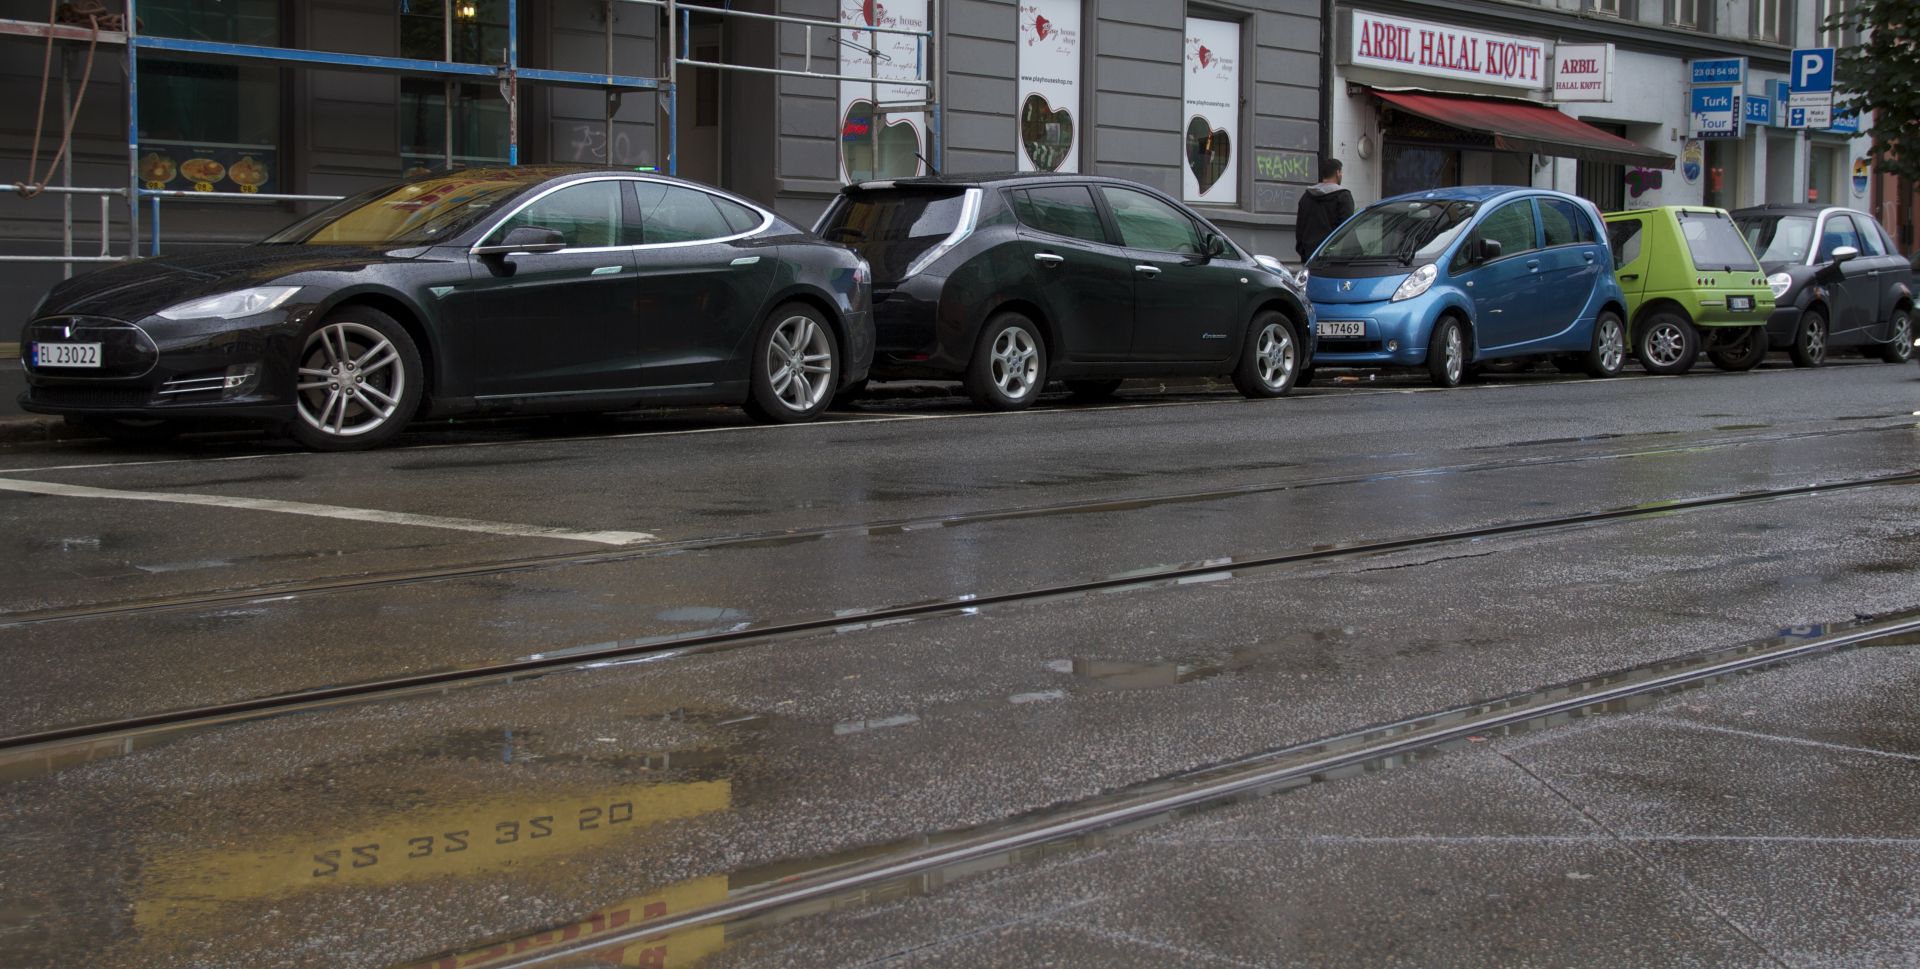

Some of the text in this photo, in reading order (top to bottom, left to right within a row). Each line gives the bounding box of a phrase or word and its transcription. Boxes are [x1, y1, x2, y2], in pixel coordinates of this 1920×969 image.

[899, 15, 923, 27] house
[1358, 19, 1541, 81] ARBIL HALAL KJØTT
[1561, 59, 1599, 74] ARBIL
[1705, 68, 1715, 76] 03
[1800, 54, 1824, 88] P
[1021, 75, 1073, 86] www.playhouseshop.no
[1556, 81, 1603, 90] HALAL KJØTT
[1702, 95, 1728, 107] Turk
[1701, 118, 1728, 129] Tour
[1257, 155, 1309, 178] FRANK!
[1329, 323, 1360, 334] 17469
[41, 346, 96, 363] EL 23022
